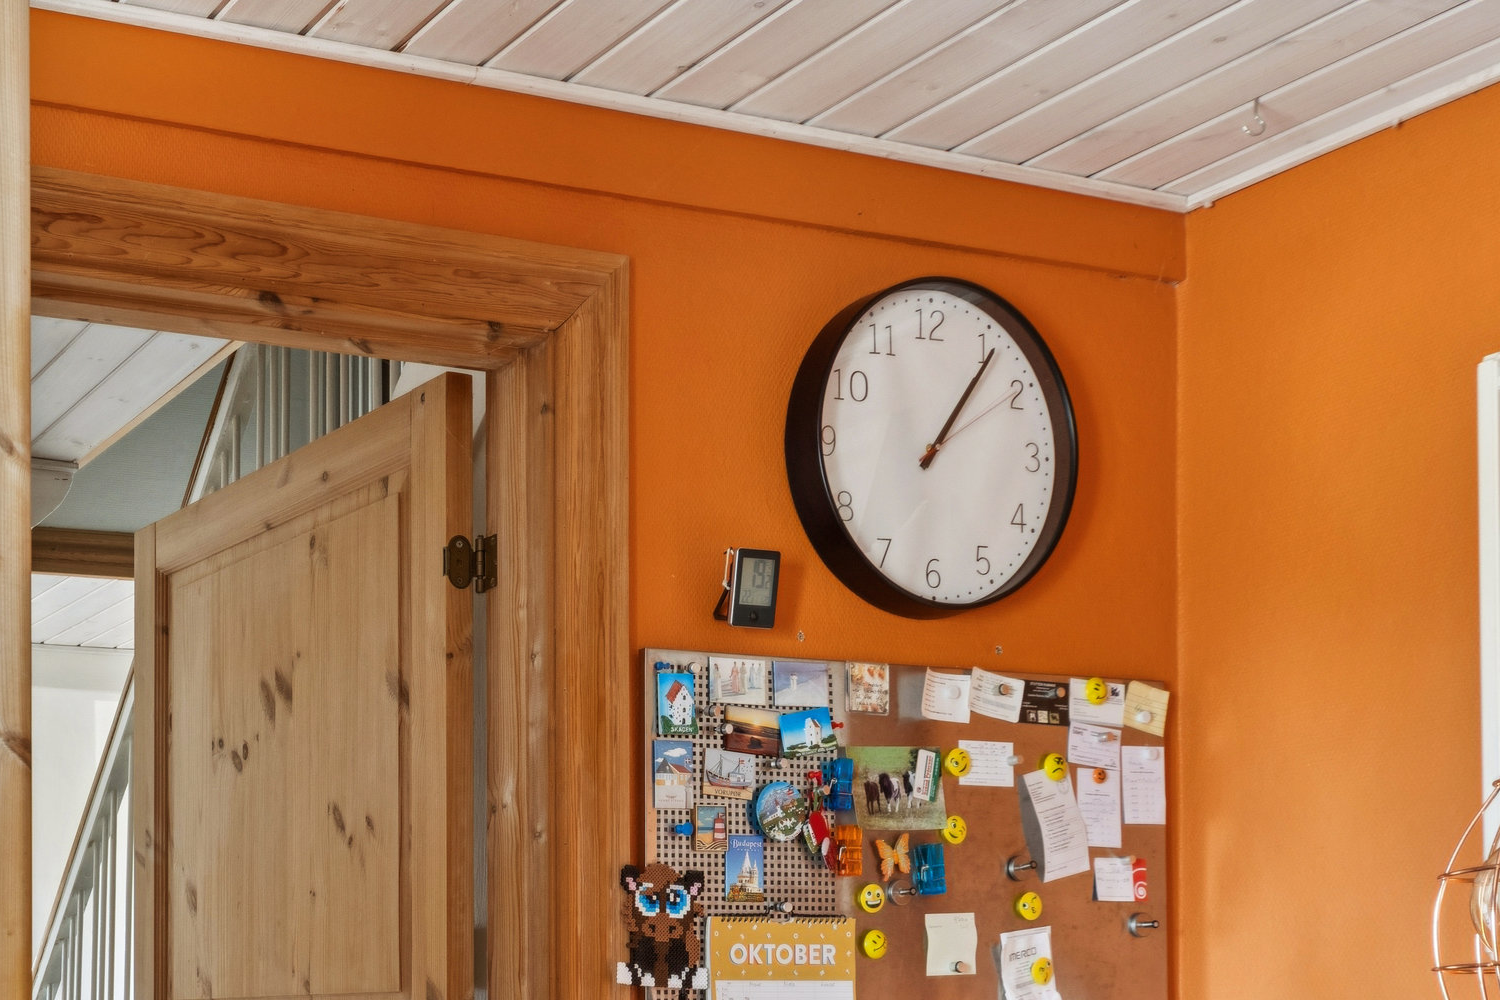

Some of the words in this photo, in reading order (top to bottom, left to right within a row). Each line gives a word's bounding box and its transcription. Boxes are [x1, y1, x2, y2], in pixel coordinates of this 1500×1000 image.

[868, 323, 897, 357] 11
[914, 308, 945, 342] 12
[833, 369, 869, 402] 10
[1010, 379, 1025, 410] 2
[821, 425, 837, 457] 9
[1025, 442, 1040, 473] 3
[837, 490, 854, 522] 8
[1010, 503, 1027, 534] 4
[876, 538, 892, 569] 7
[975, 545, 991, 576] 5
[925, 558, 941, 589] 6
[732, 839, 762, 849] Budapest
[729, 943, 836, 966] OKTOBER
